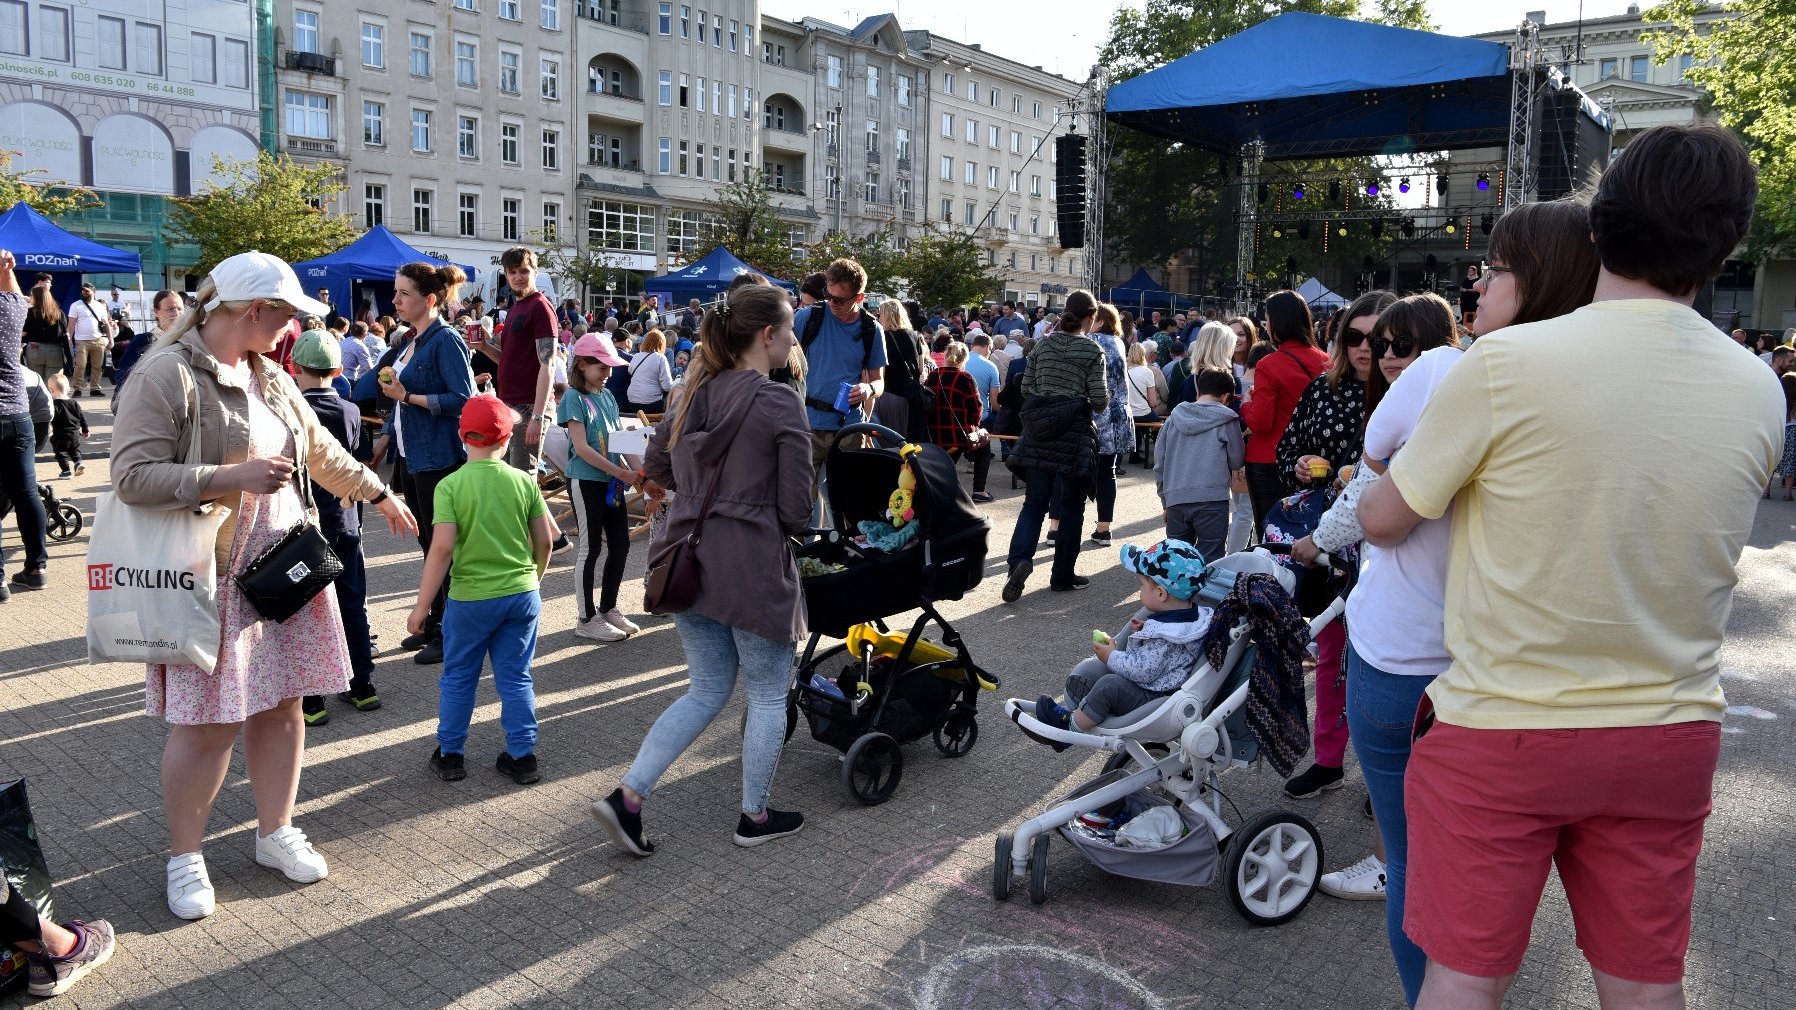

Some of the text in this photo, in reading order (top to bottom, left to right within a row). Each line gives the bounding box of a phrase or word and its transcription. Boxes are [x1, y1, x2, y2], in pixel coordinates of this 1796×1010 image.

[71, 72, 91, 82] 608
[94, 74, 113, 85] 635
[117, 78, 136, 88] 020
[147, 83, 160, 92] 66
[162, 84, 174, 94] 44
[177, 86, 195, 97] 888
[90, 565, 195, 590] RECYKLING
[114, 639, 178, 650] www.remondis.pl
